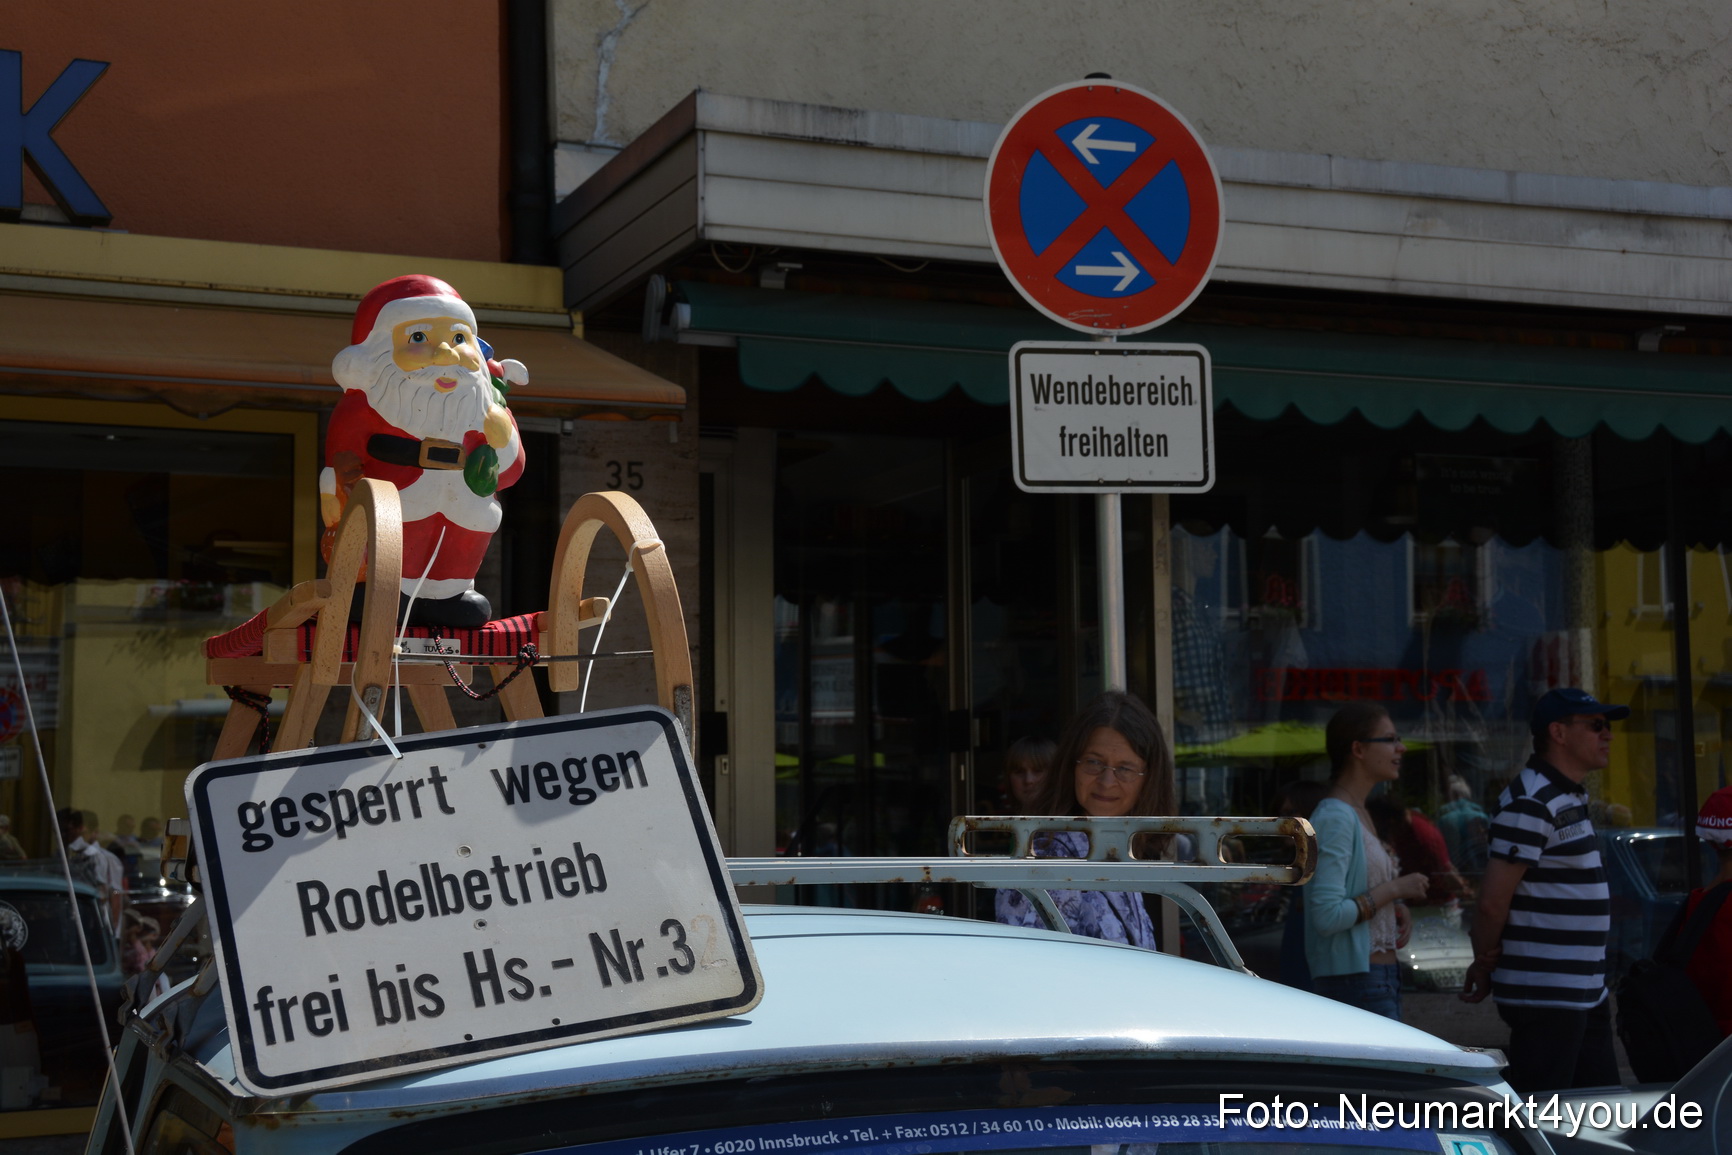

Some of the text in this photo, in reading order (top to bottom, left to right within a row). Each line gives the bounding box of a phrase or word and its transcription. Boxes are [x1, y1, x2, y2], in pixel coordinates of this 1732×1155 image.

[0, 48, 113, 219] K
[1029, 373, 1193, 406] Wendebereich
[1059, 425, 1169, 457] freihalten
[606, 460, 644, 490] 35
[1460, 470, 1478, 479] not
[237, 749, 649, 853] gesperrt wegen
[296, 841, 608, 937] Rodelbetrieb
[253, 973, 350, 1047] frei
[366, 963, 446, 1027] bis
[714, 1138, 756, 1155] 6020
[758, 1130, 840, 1150] Innsbruck
[849, 1127, 880, 1142] Tel.
[894, 1125, 928, 1140] Fax:
[929, 1122, 969, 1137] 0512
[980, 1120, 1001, 1134] 34
[1003, 1119, 1023, 1133] 60
[1025, 1118, 1044, 1132] 10
[1055, 1115, 1104, 1131] Mobil:
[1104, 1115, 1142, 1129] 0664
[1151, 1114, 1180, 1128] 938
[1181, 1114, 1201, 1128] 28
[1201, 1114, 1220, 1128] 35
